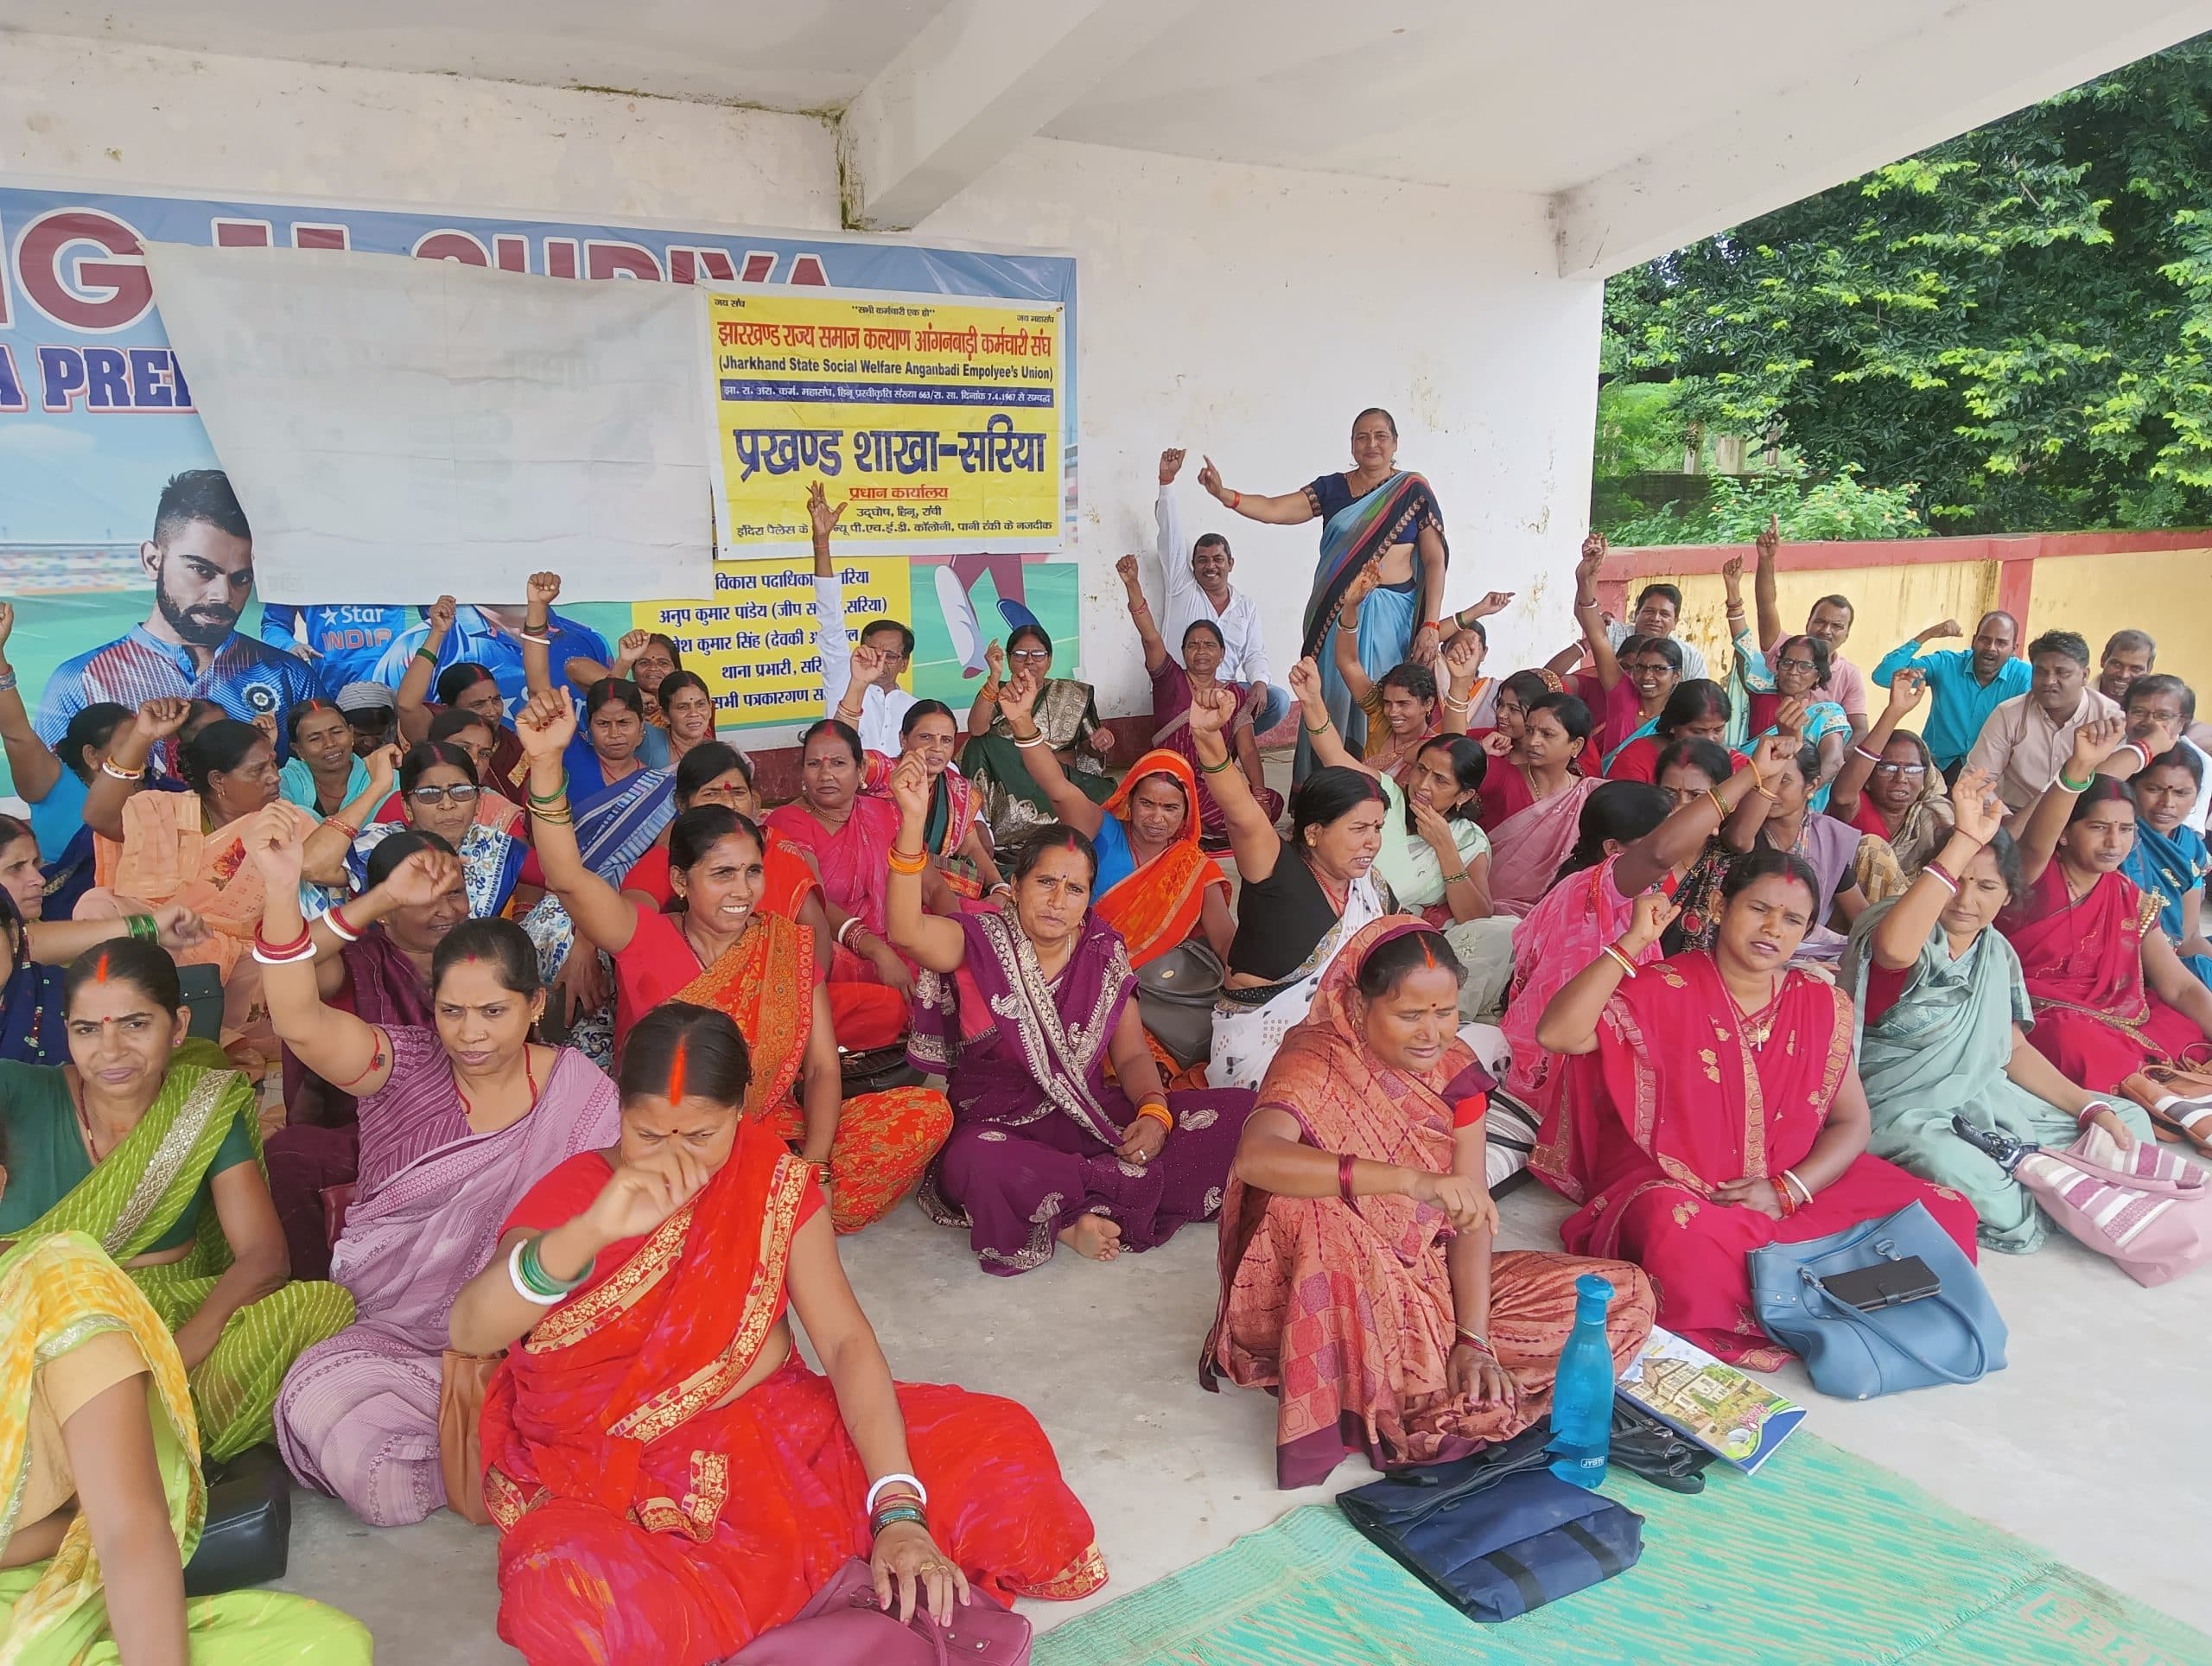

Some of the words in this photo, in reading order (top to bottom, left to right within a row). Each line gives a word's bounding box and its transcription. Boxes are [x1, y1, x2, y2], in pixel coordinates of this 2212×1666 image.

[717, 321, 780, 347] झारखण्ड
[782, 324, 816, 347] राज्य
[818, 326, 861, 349] समाज
[863, 327, 912, 351] कल्याण
[981, 327, 1029, 356] कर्मचारी
[1031, 327, 1052, 357] संघ
[719, 355, 786, 372] (Jharkhand
[790, 357, 820, 372] State
[823, 359, 857, 373] Social
[861, 359, 902, 374] Welfare
[905, 361, 960, 378] Anganbadi
[1021, 366, 1053, 382] Union)
[36, 346, 197, 413] PRE
[1017, 392, 1025, 401] से
[733, 429, 843, 483] प्रखण्ड
[849, 486, 887, 500] प्रधान
[892, 484, 949, 499] कार्यालय
[922, 505, 942, 516] रांची
[798, 524, 809, 534] के
[957, 520, 980, 531] पानी
[1003, 520, 1014, 530] के
[1016, 519, 1053, 531] नजदीक
[715, 572, 757, 590] विकास
[341, 606, 385, 624] Star
[659, 607, 690, 627] अनुप
[696, 606, 730, 626] कुमार
[735, 601, 767, 620] पांडेय
[321, 628, 392, 651] INDIA
[697, 635, 732, 656] कुमार
[737, 632, 760, 649] सिंह
[765, 629, 804, 649] (देवकी
[722, 664, 751, 680] थाना
[743, 690, 809, 707] पत्रकारगण
